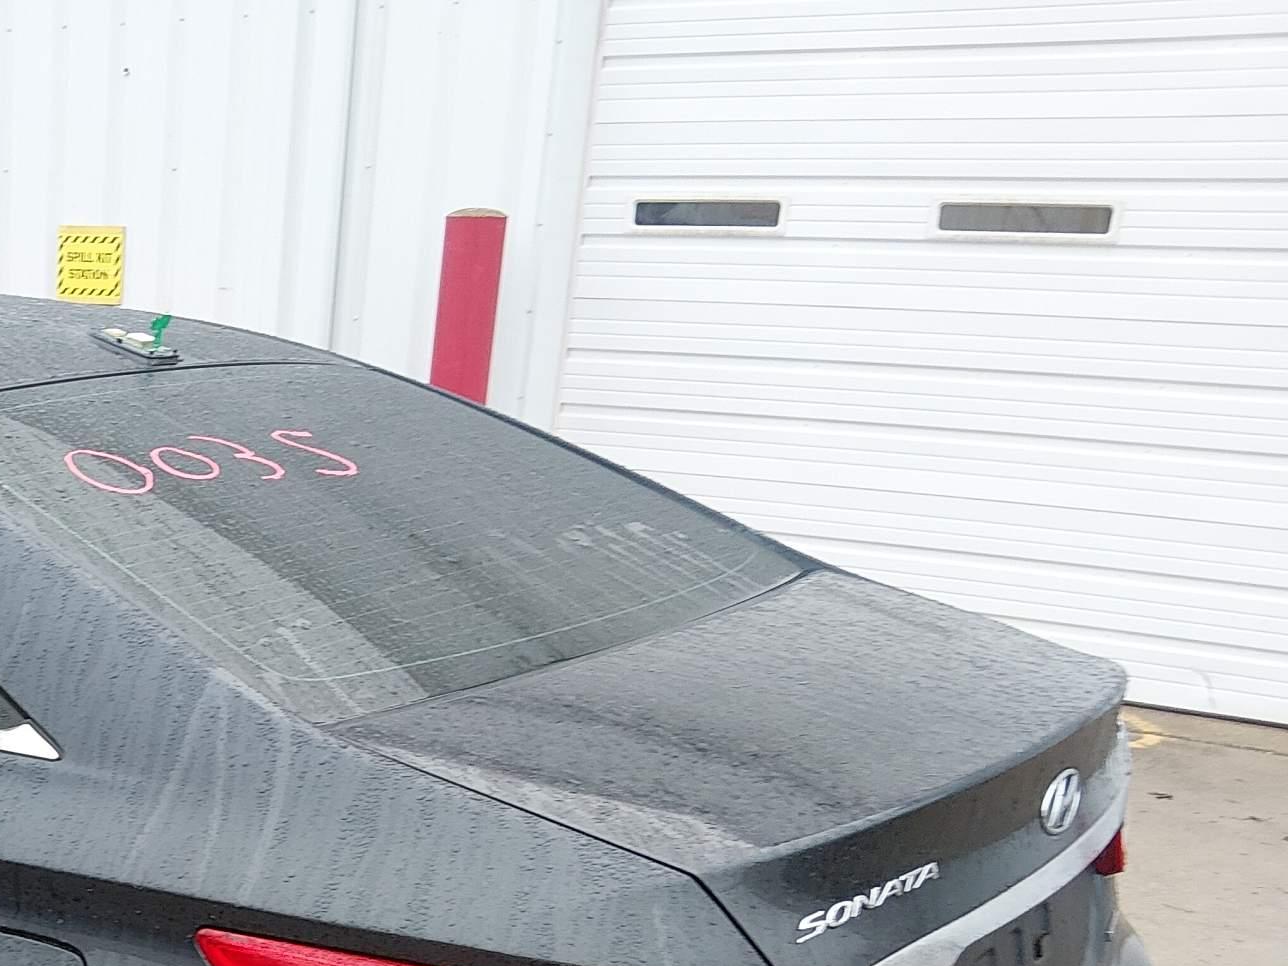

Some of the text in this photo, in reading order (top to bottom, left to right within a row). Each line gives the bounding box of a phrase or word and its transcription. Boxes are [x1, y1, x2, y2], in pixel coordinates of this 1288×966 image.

[66, 251, 94, 263] SPILL
[67, 268, 109, 280] STATION
[64, 429, 359, 495] 0035
[795, 861, 941, 944] SONATA
